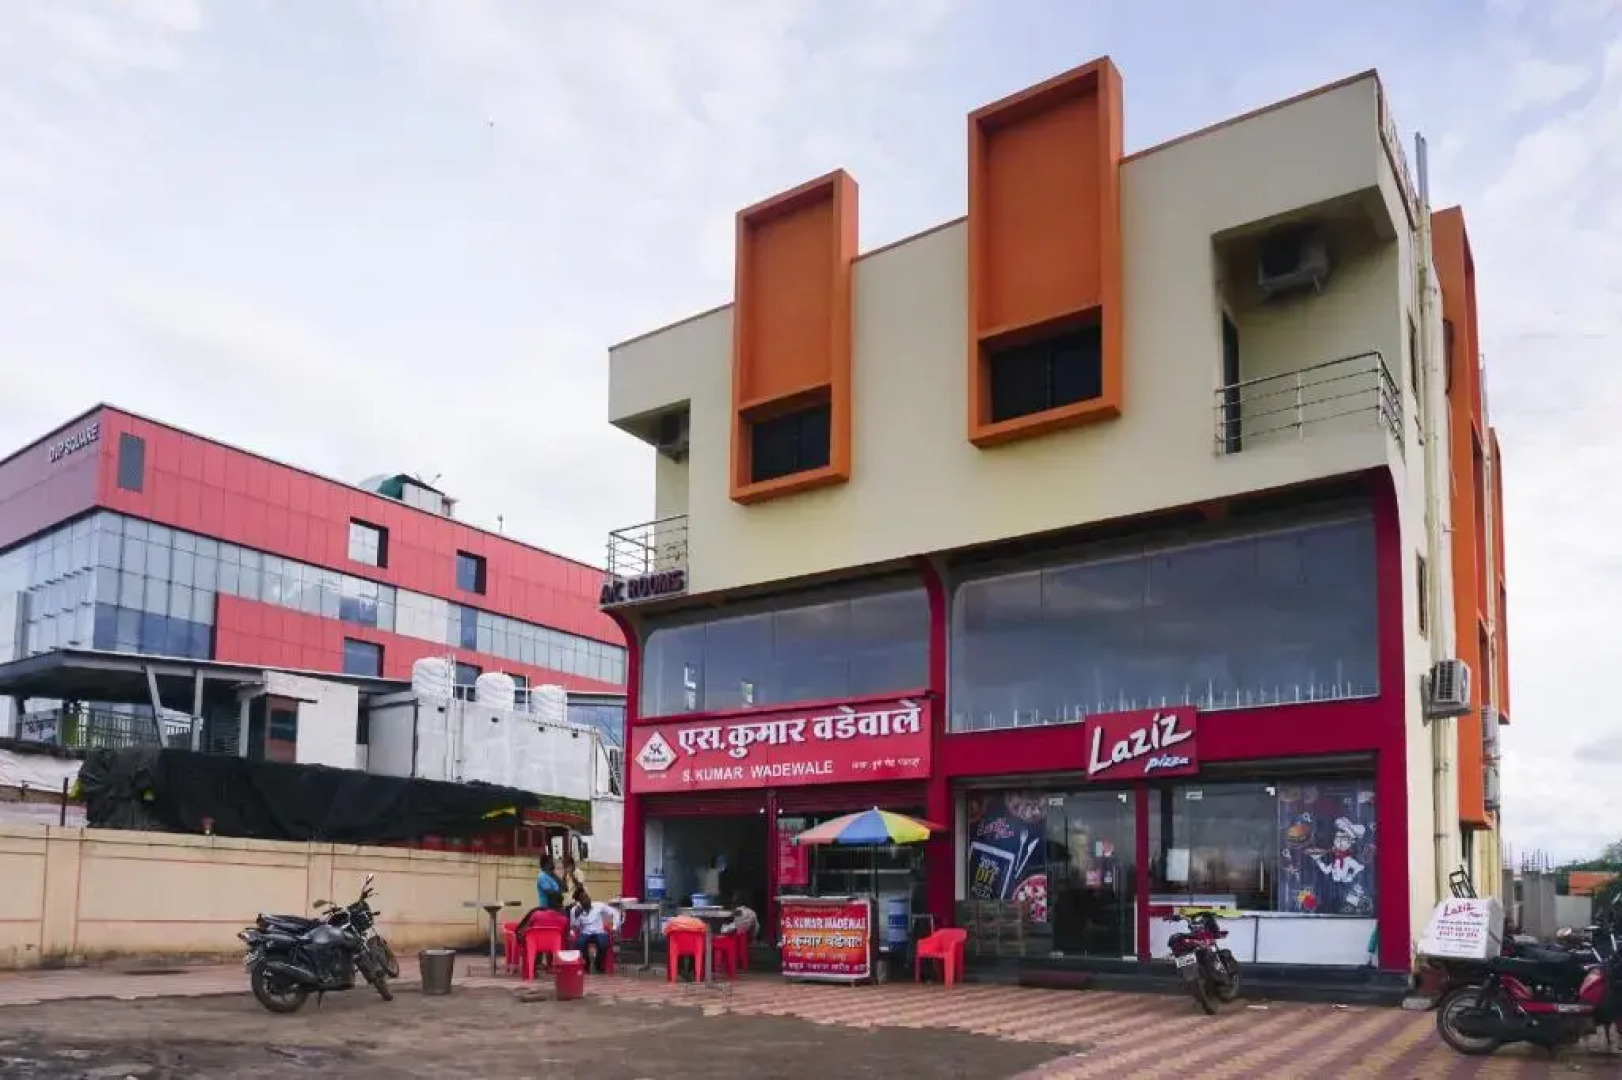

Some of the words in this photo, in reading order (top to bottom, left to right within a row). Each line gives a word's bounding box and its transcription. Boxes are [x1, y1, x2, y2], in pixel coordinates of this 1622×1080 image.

[628, 569, 684, 598] ROOMS
[812, 699, 922, 740] वडेवाले
[1089, 712, 1192, 774] Laziz
[750, 760, 834, 779] WADEWALE
[1144, 754, 1189, 774] pizza
